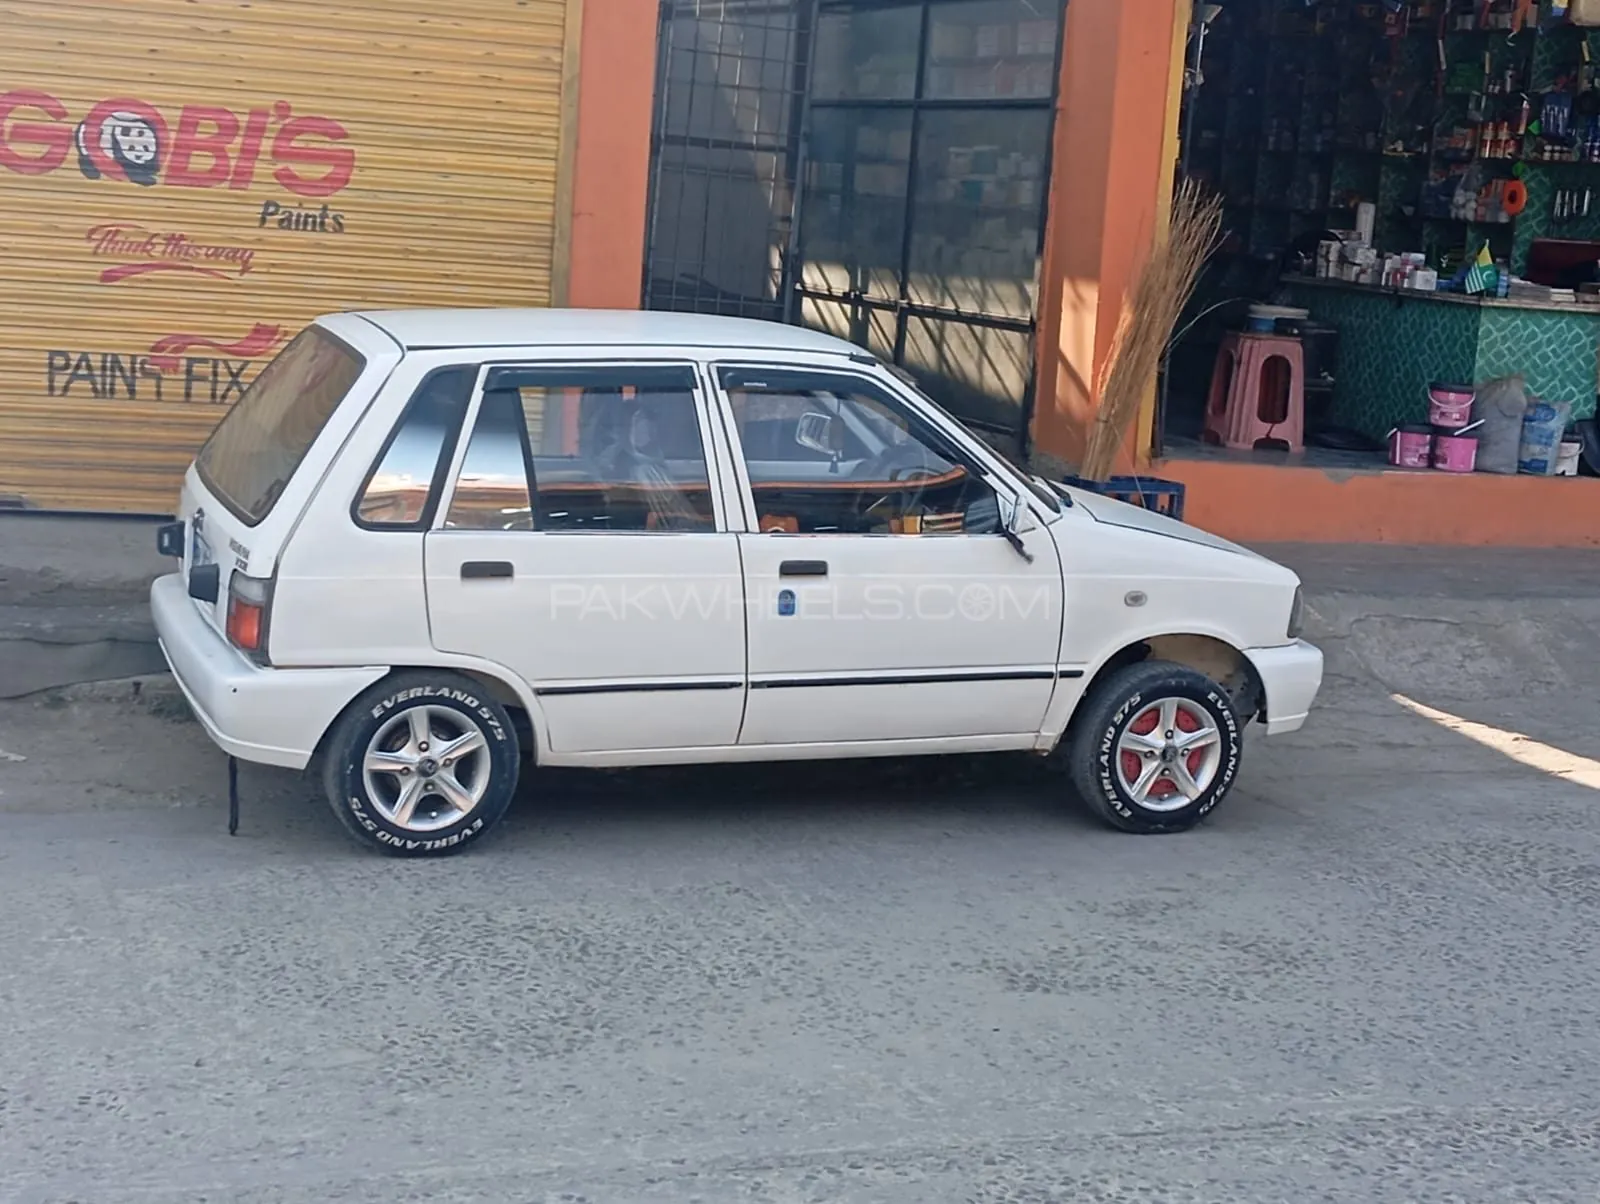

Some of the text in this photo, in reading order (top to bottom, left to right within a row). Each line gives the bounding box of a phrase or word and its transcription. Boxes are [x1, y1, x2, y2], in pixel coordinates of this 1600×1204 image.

[0, 88, 356, 198] GOBI'S
[259, 200, 345, 233] Paints
[85, 224, 255, 276] Think this way
[185, 358, 253, 404] FIX
[370, 686, 480, 719] EVERLAND
[1207, 692, 1237, 782] EVERLAND
[1100, 725, 1132, 817] EVERLAND
[376, 818, 484, 850] EVERLAND
